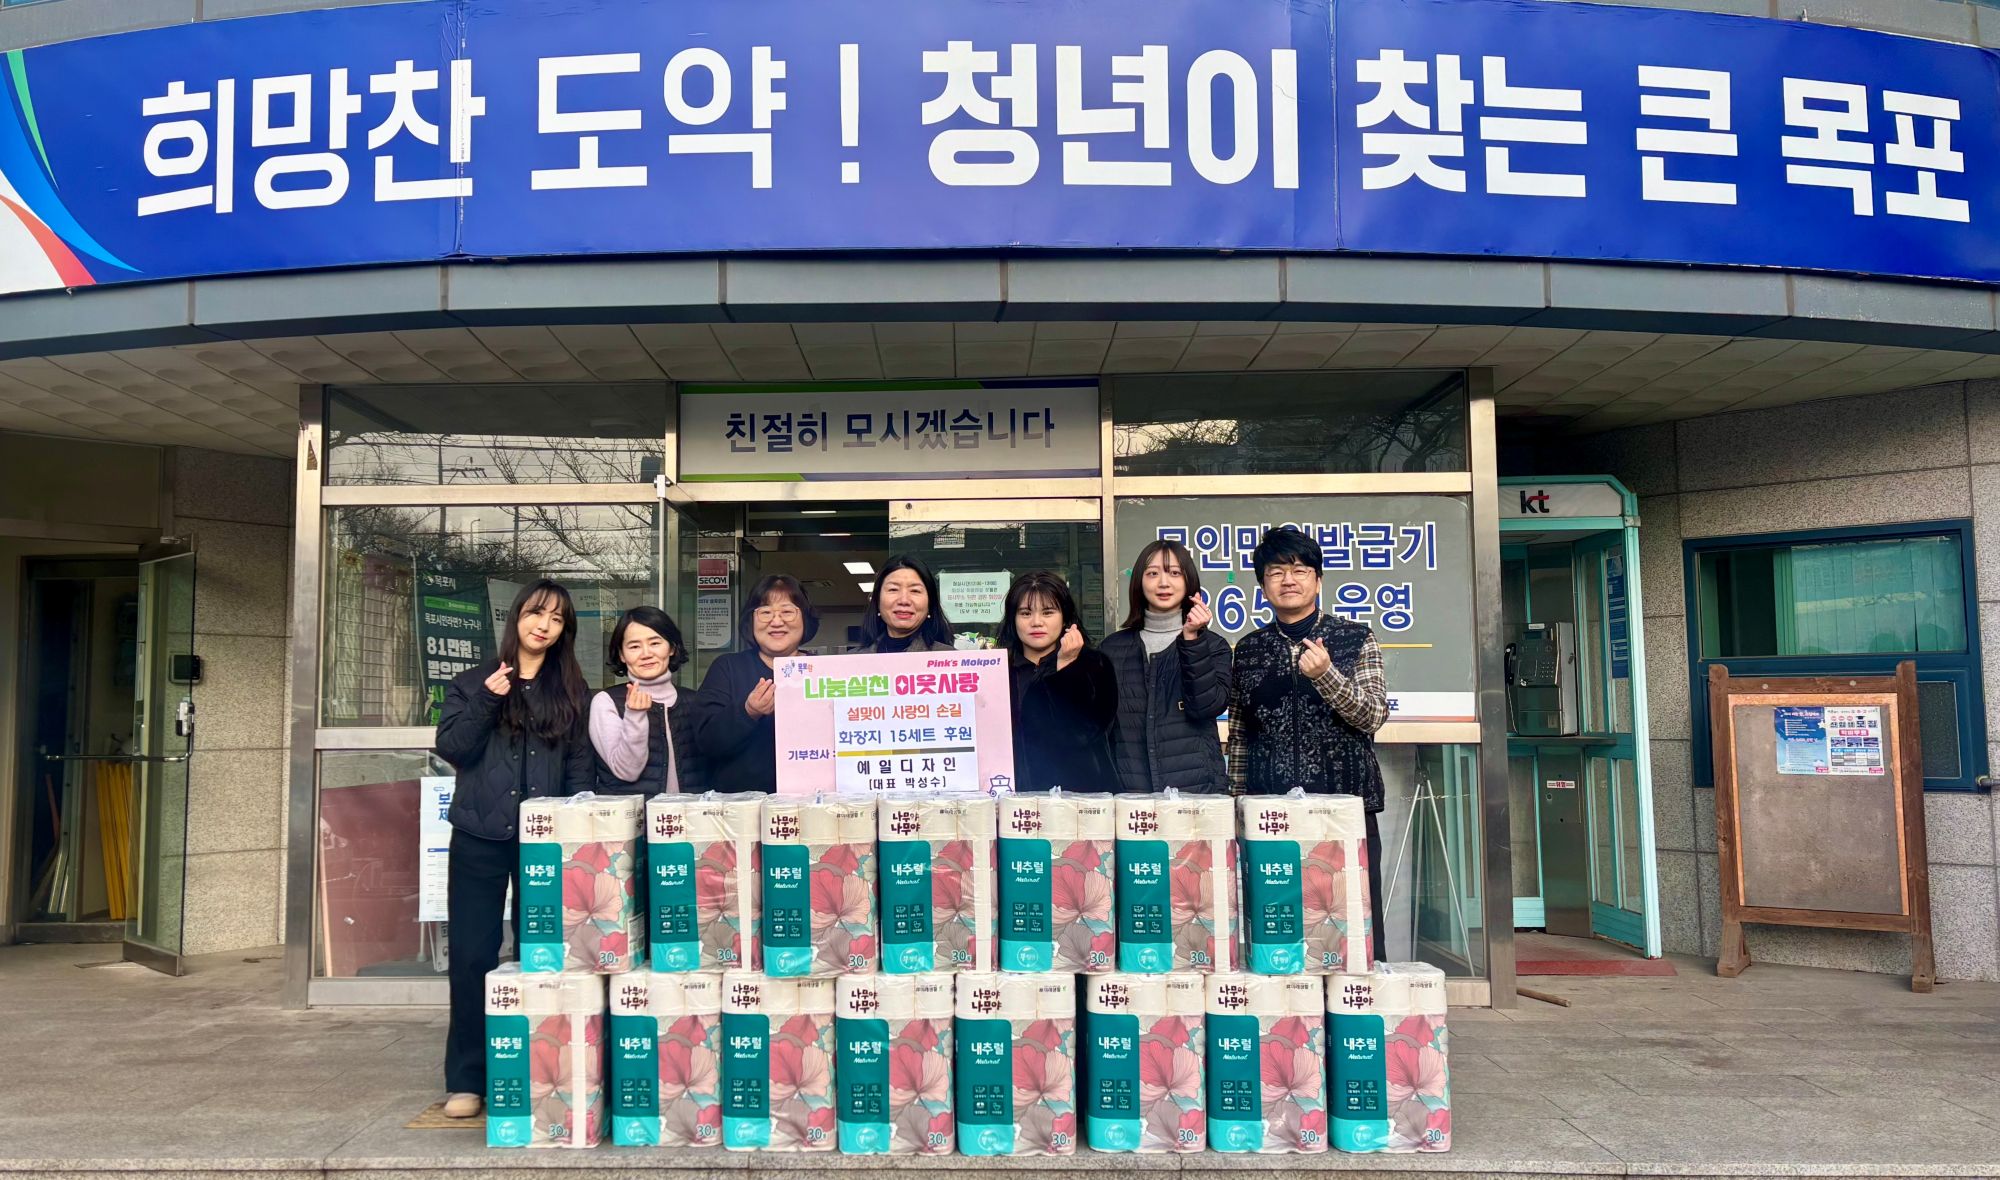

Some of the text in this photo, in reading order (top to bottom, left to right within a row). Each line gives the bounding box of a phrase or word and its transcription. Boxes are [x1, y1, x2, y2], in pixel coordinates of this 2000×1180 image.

[138, 41, 1970, 223] 희망찬 도약 ! 청년이 찾는 큰 목포
[725, 407, 1055, 453] 친절히 모시겠습니다
[1520, 490, 1550, 514] kt
[435, 575, 456, 589] 목포시
[1332, 582, 1413, 632] 운영
[427, 637, 473, 659] 81만원
[927, 658, 1001, 668] Pink's Mokpo!
[804, 673, 979, 698] 나눔실천 이웃사랑
[847, 703, 962, 721] 설맞이 사랑의 손길
[839, 727, 972, 745] 화장지 15세트 후원
[788, 750, 829, 760] 기부천사
[527, 814, 552, 824] 나무야
[657, 813, 683, 824] 나무야
[772, 815, 798, 826] 나무야
[893, 811, 919, 822] 나무야
[1014, 809, 1040, 820] 나무야
[1130, 810, 1157, 821] 나무야
[1260, 810, 1288, 821] 나무야
[526, 825, 553, 837] 나무야
[656, 825, 684, 837] 나무야
[891, 823, 920, 835] 나무야
[1012, 820, 1041, 833] 나무야
[1129, 822, 1158, 835] 나무야
[1259, 822, 1289, 835] 나무야
[770, 827, 800, 839] 나무야
[525, 864, 555, 877] 내추럴
[657, 864, 687, 877] 내추럴
[891, 863, 924, 876] 내추럴
[1012, 861, 1043, 873] 내추럴
[1129, 863, 1161, 875] 내추럴
[1260, 863, 1293, 876] 내추럴
[770, 868, 801, 880] 내추럴
[493, 986, 518, 996] 나무야
[622, 986, 648, 996] 나무야
[733, 983, 759, 994] 나무야
[851, 989, 878, 999] 나무야
[974, 989, 1000, 999] 나무야
[1101, 984, 1128, 994] 나무야
[1220, 984, 1247, 995] 나무야
[1345, 984, 1372, 995] 나무야
[491, 997, 520, 1009] 나무야
[621, 997, 648, 1009] 나무야
[731, 996, 760, 1008] 나무야
[850, 1000, 879, 1013] 나무야
[972, 1001, 1002, 1014] 나무야
[1099, 995, 1129, 1009] 나무야
[1218, 996, 1249, 1009] 나무야
[1343, 996, 1373, 1009] 나무야
[491, 1038, 522, 1050] 내추럴
[620, 1038, 651, 1050] 내추럴
[731, 1036, 762, 1050] 내추럴
[849, 1041, 881, 1053] 내추럴
[972, 1043, 1004, 1055] 내추럴
[1099, 1037, 1131, 1050] 내추럴
[1219, 1038, 1252, 1050] 내추럴
[1344, 1038, 1377, 1050] 내추럴
